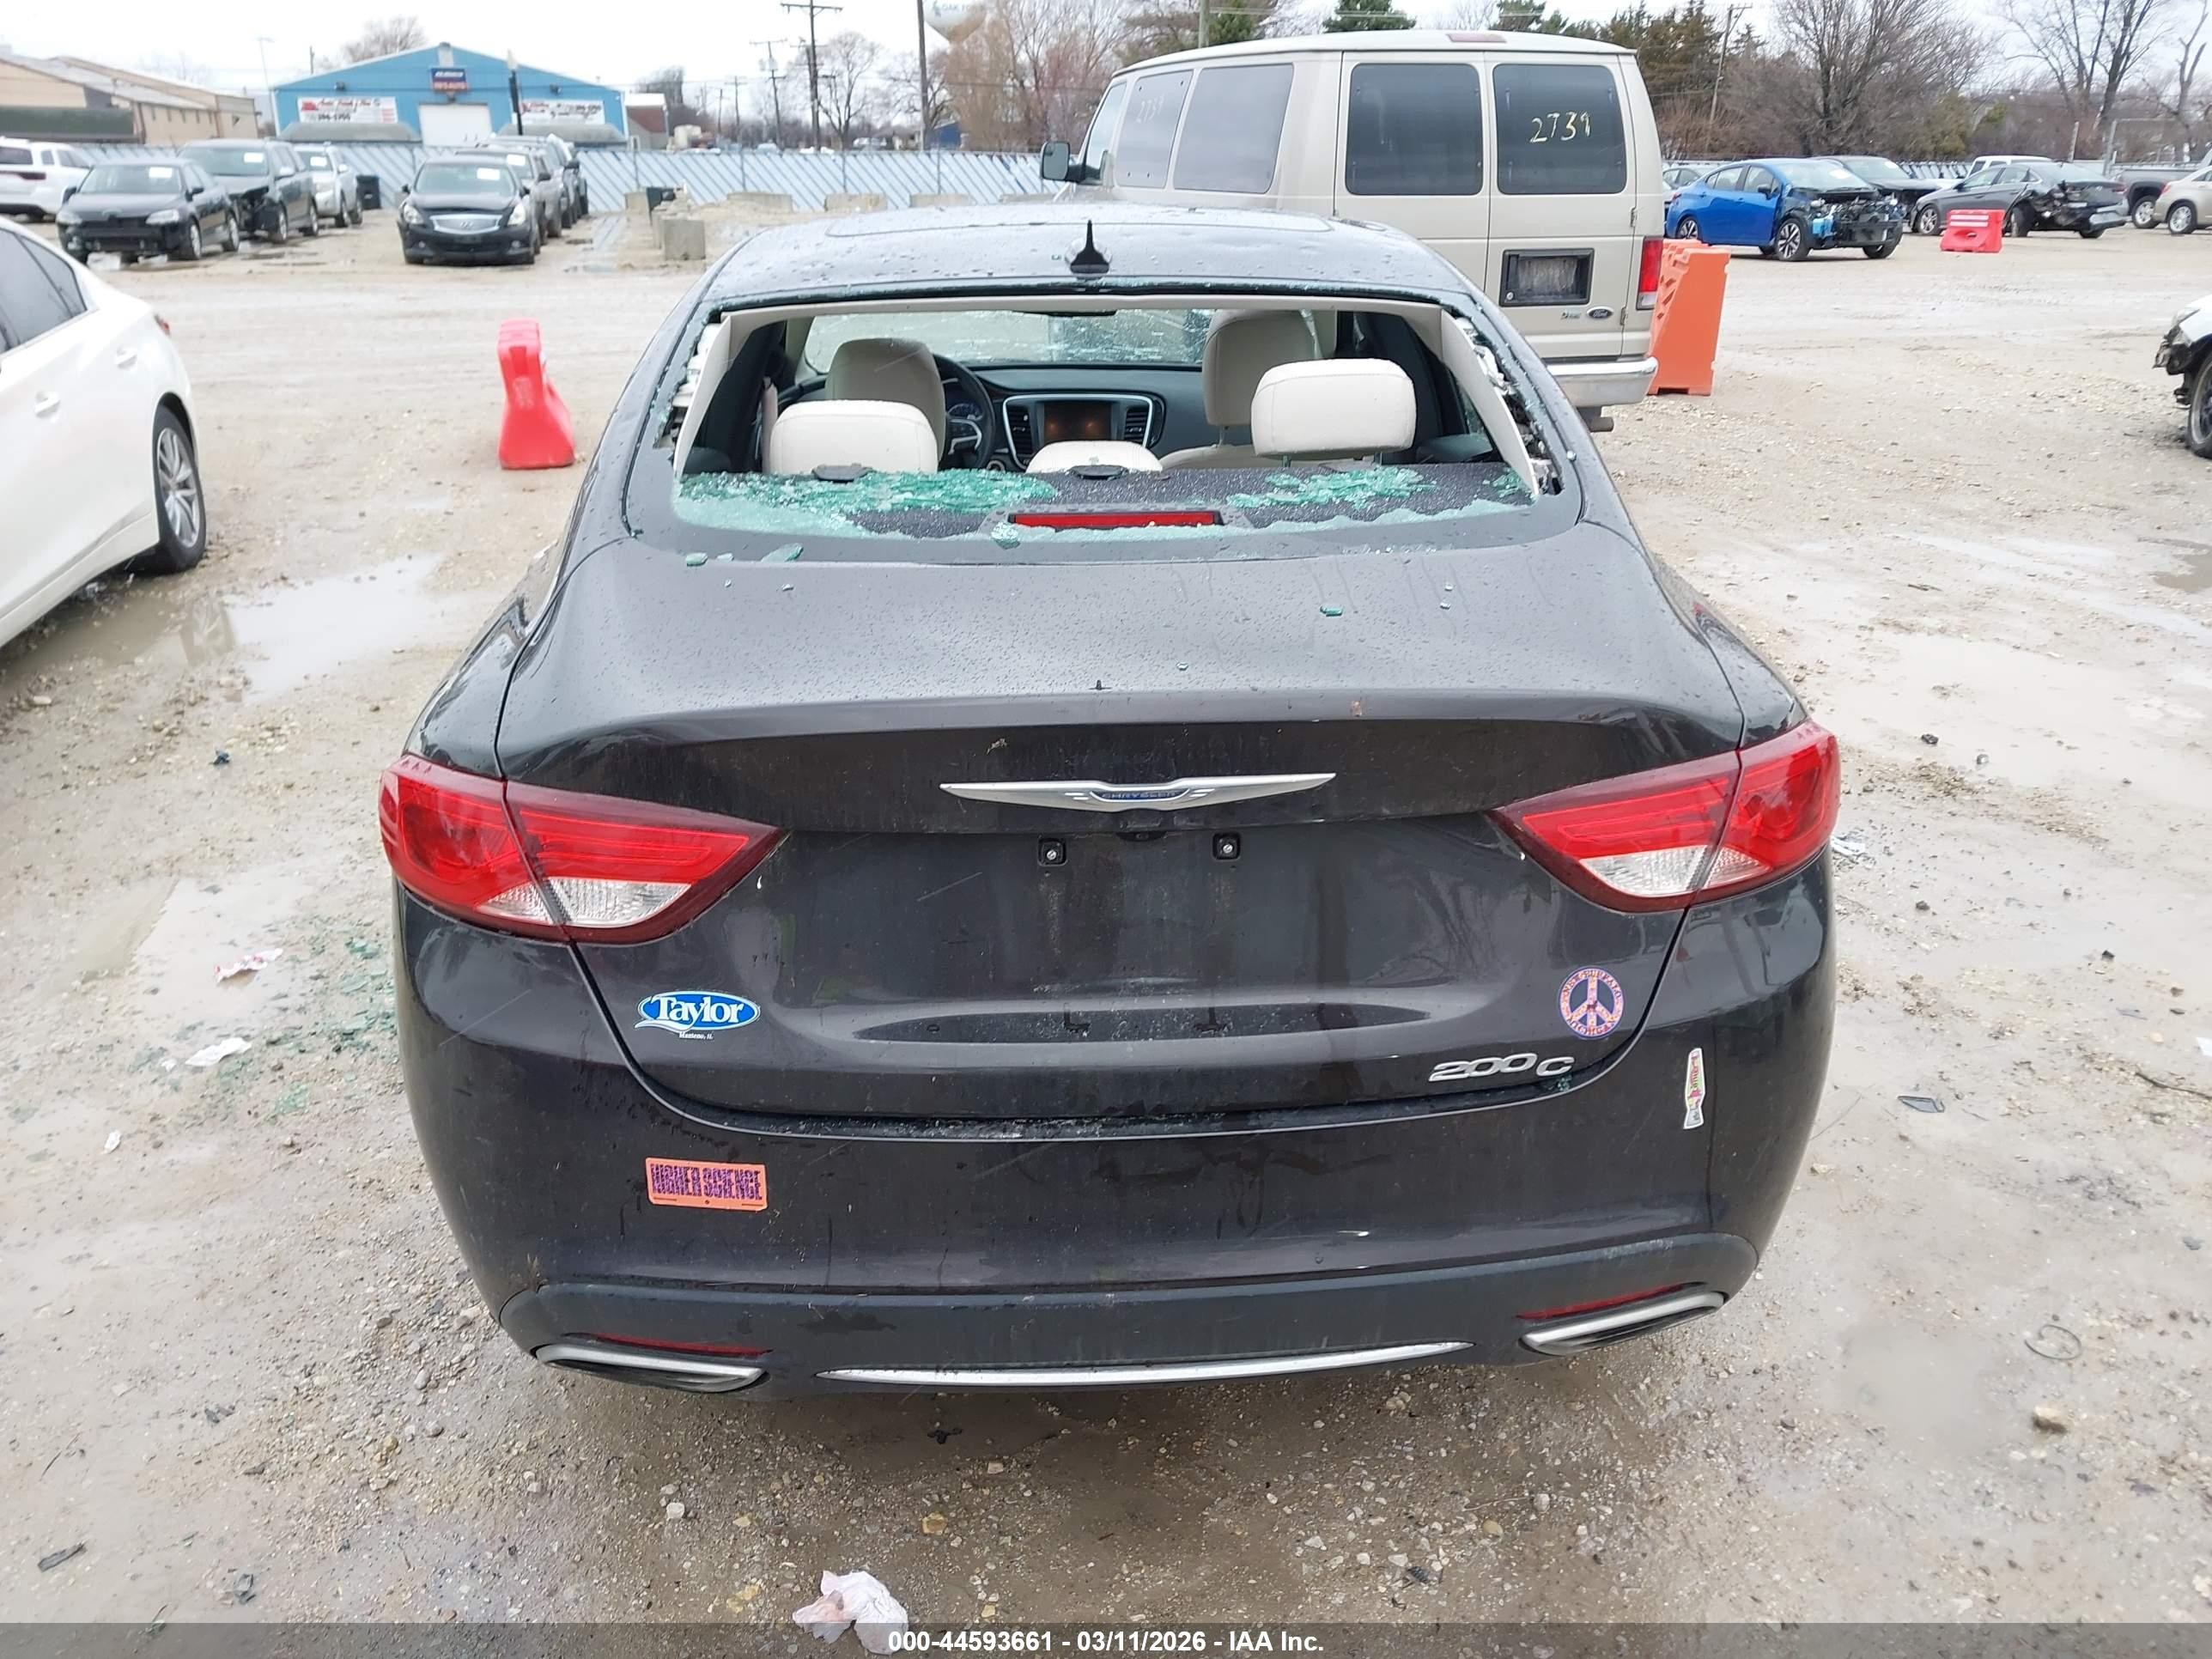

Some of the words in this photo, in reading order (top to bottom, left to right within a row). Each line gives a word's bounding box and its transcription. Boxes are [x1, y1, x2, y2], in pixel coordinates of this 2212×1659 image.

[1529, 111, 1591, 143] 2739
[650, 995, 745, 1028] Taylor
[702, 1167, 763, 1201] SCIENCE
